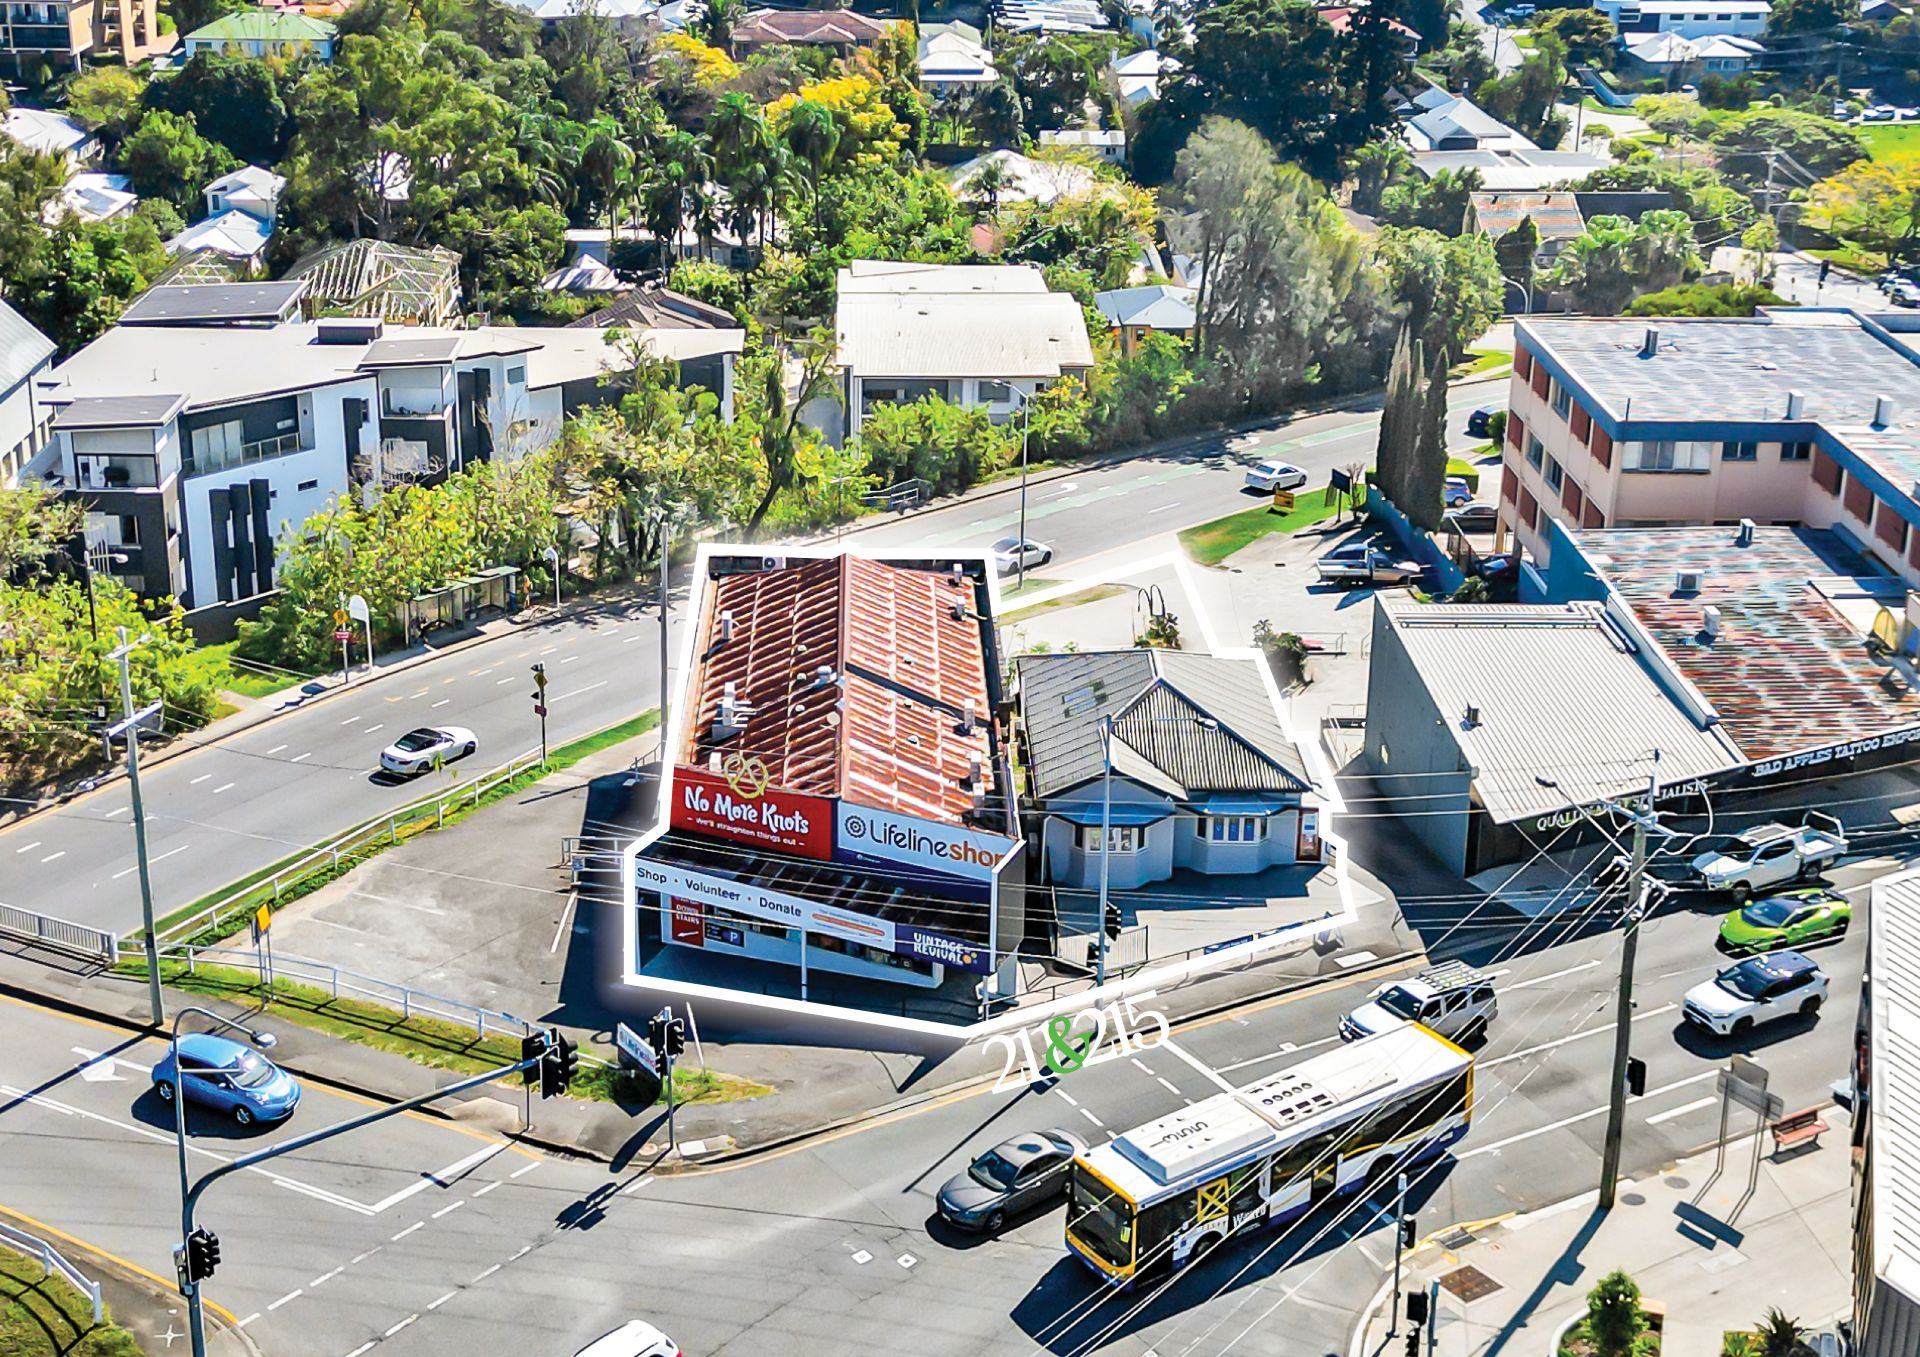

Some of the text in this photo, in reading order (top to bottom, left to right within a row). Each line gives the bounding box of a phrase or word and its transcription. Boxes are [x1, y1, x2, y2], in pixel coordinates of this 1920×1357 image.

[1753, 761, 1782, 777] BAD
[1784, 749, 1832, 770] APPLES
[1834, 738, 1880, 758] TATTOO
[1632, 779, 1708, 807] SPIALISTS
[685, 786, 809, 834] No More Knots
[1537, 808, 1589, 831] QUALI
[716, 822, 755, 837] straighten
[757, 831, 781, 843] things
[783, 837, 796, 846] out
[637, 867, 802, 917] Shop Volunteer Donate
[676, 912, 700, 925] STAIRS
[730, 931, 738, 942] P
[913, 932, 964, 954] VINTAGE
[913, 942, 964, 965] REVIVAL
